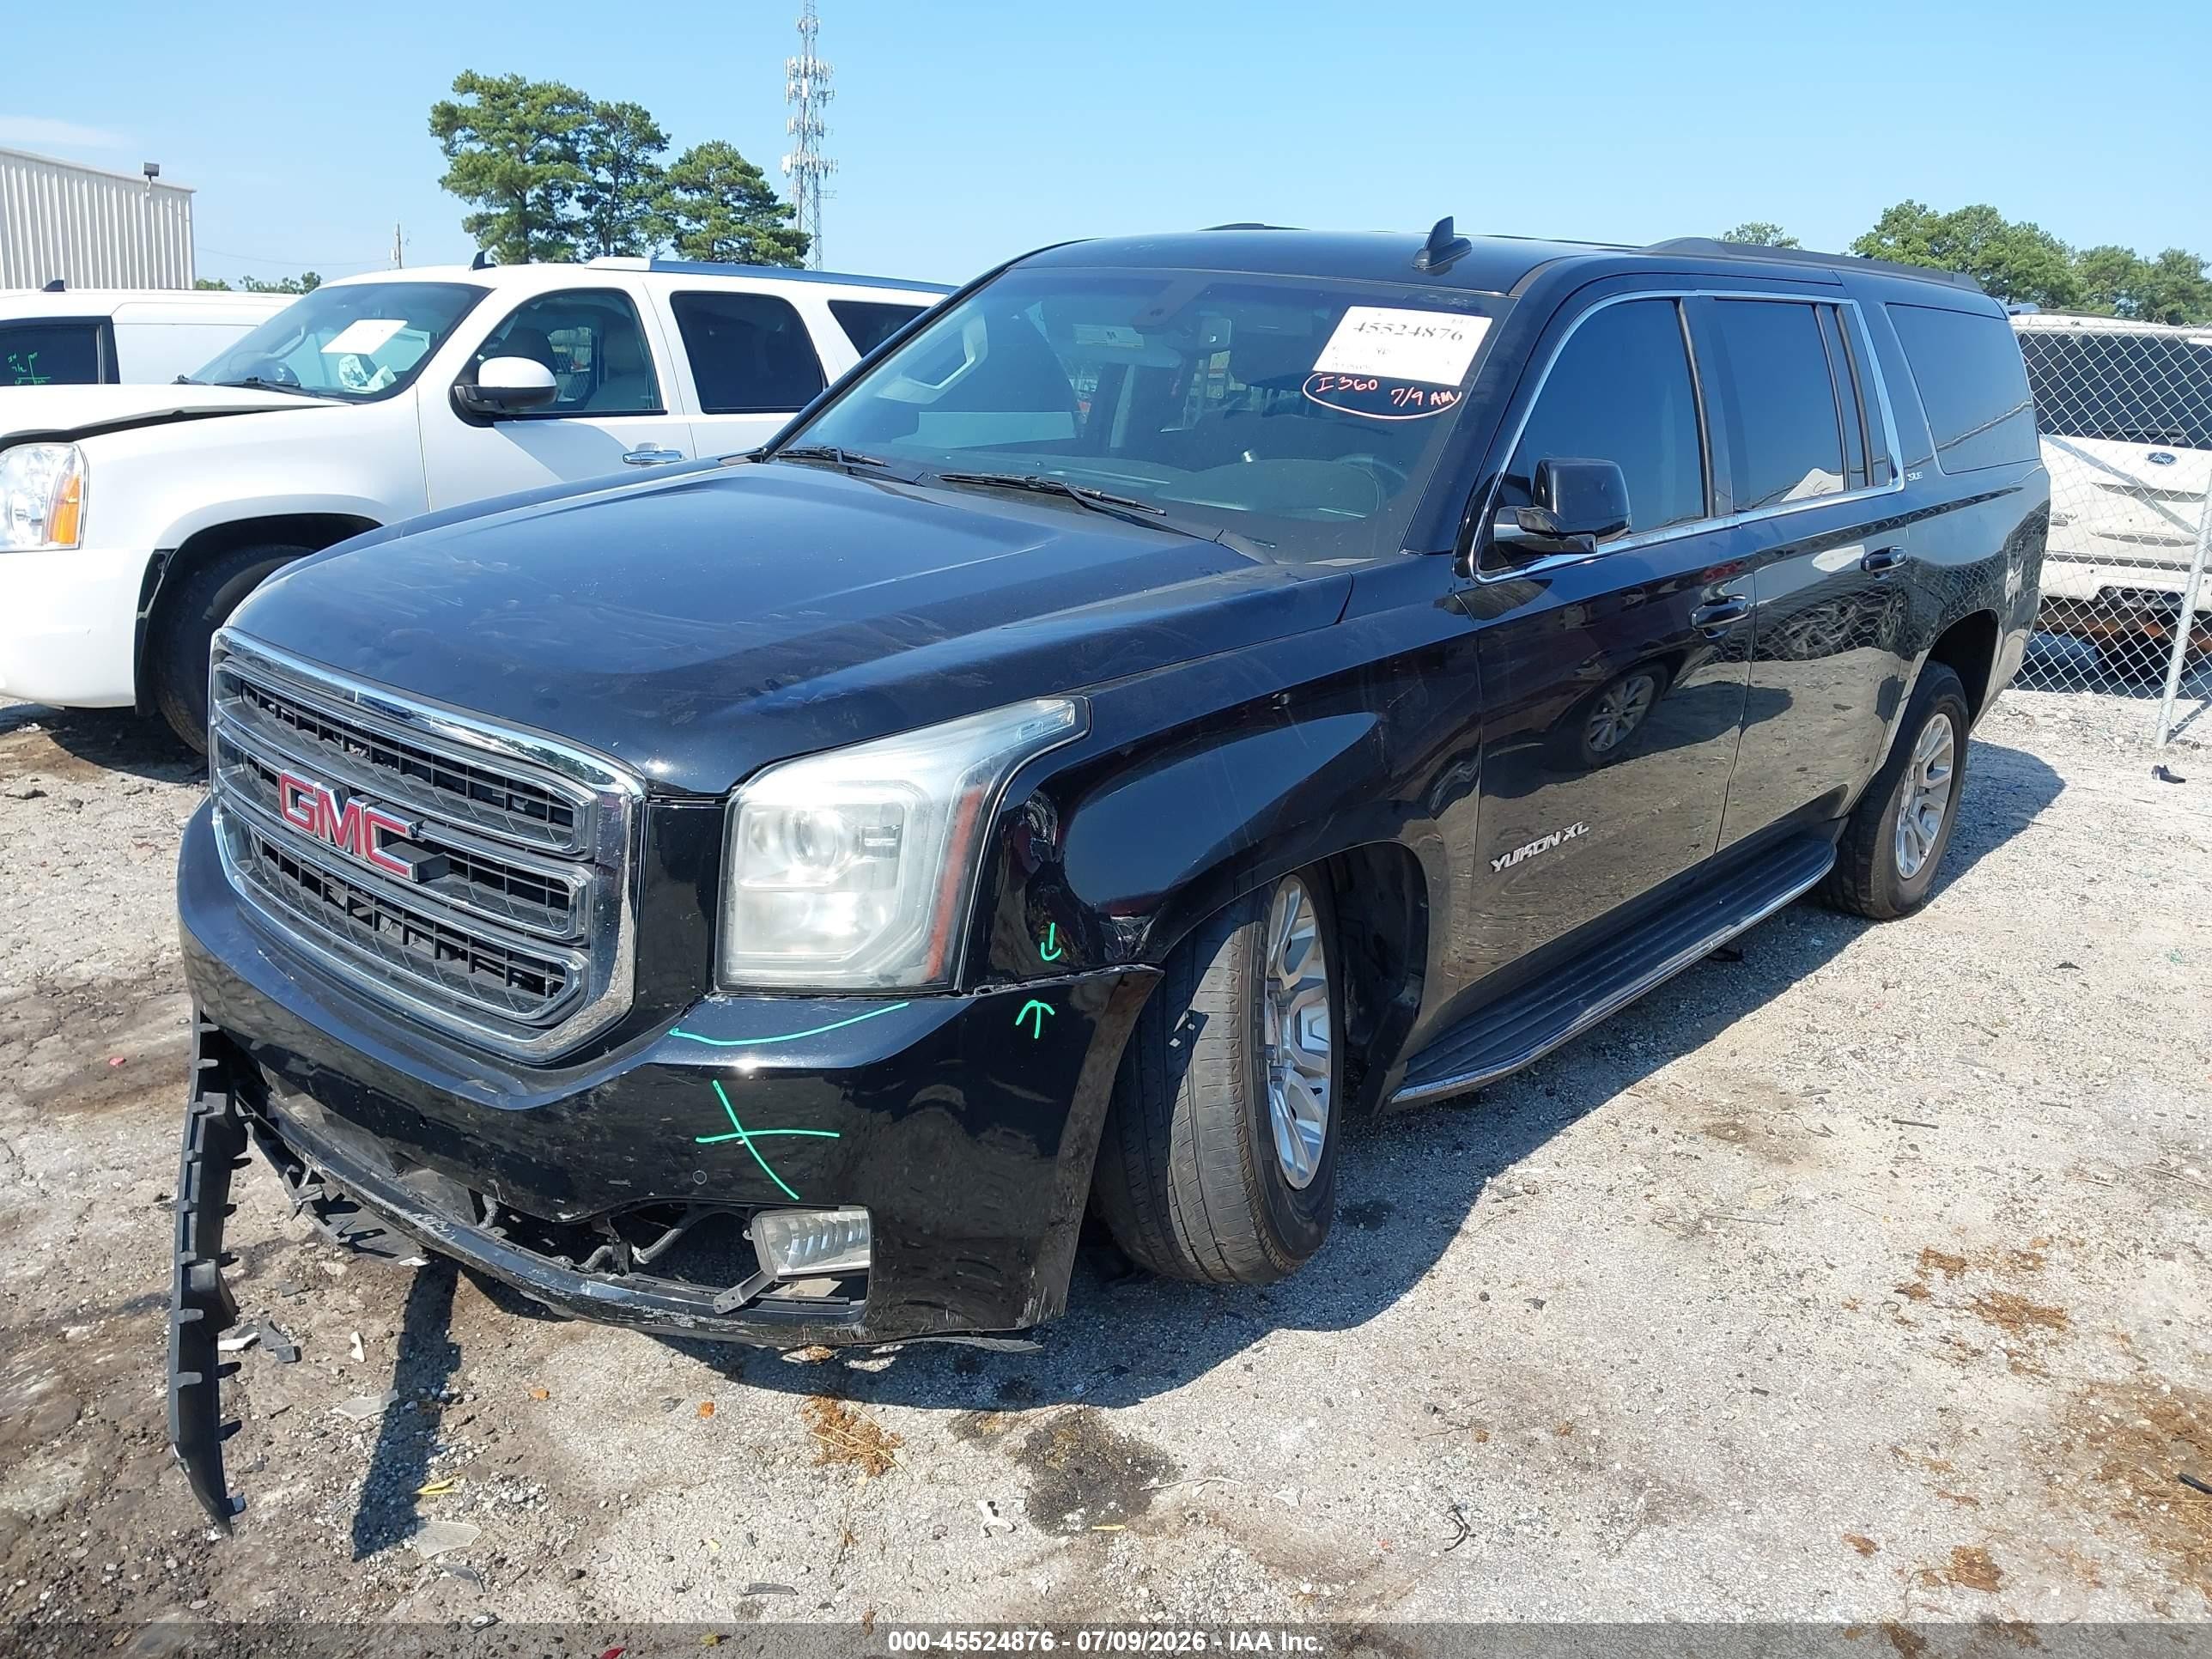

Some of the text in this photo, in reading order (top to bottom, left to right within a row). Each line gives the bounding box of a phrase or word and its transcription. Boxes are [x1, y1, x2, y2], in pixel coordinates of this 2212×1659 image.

[1353, 320, 1463, 342] 45524876
[1390, 387, 1455, 407] 7/9 AM
[280, 769, 418, 882] GMC
[1491, 821, 1589, 873] YUKON XL
